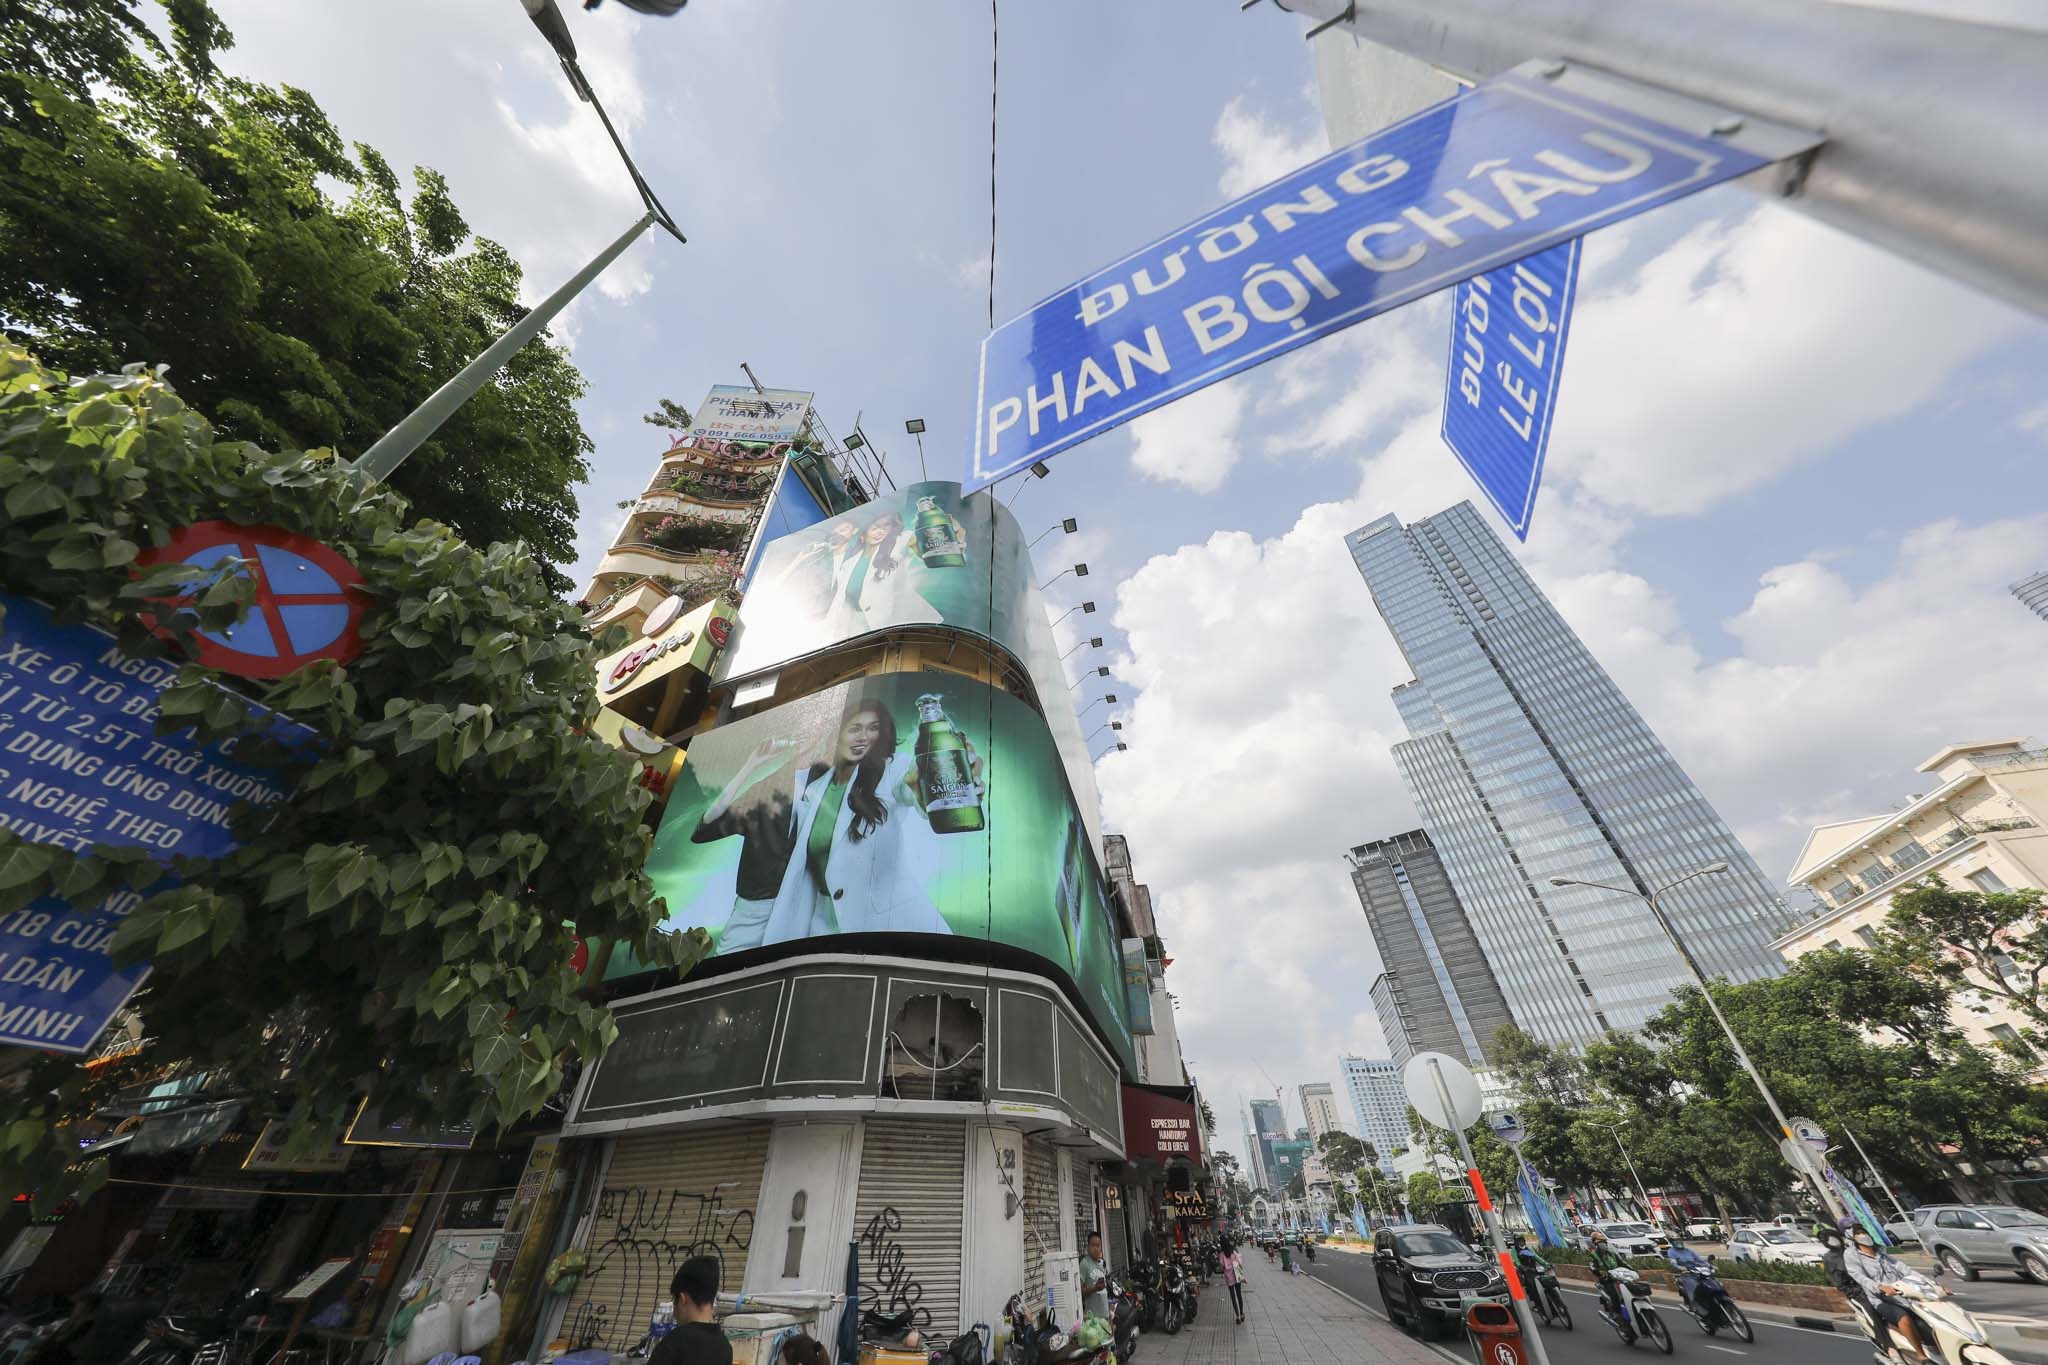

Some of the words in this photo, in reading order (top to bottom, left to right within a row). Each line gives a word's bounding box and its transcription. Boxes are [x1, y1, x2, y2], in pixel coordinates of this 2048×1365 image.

[1075, 154, 1410, 328] ĐƯỜNG
[988, 325, 1171, 456] PHAN
[1183, 255, 1341, 355] BỘI
[1346, 131, 1653, 273] CHÂU
[1509, 264, 1557, 369] LỢI
[1496, 361, 1537, 442] LÊ
[0, 643, 52, 674] XE
[48, 662, 83, 685] Ô
[79, 676, 126, 704] TÔ
[99, 648, 180, 693] NGOẠ
[5, 731, 103, 777] DỤNG
[101, 763, 170, 802] ỨNG
[20, 692, 75, 723] TỪ
[65, 714, 141, 751] 2,5T
[142, 741, 203, 776] TRỞ
[8, 778, 109, 827] NGHỆ
[106, 809, 184, 849] THEO
[930, 782, 967, 794] SAIGON
[1, 956, 85, 993] DÂN
[1151, 1118, 1178, 1129] ESPRESSO
[1179, 1119, 1191, 1129] BAR
[1157, 1141, 1172, 1152] COLD
[1172, 1141, 1190, 1152] BREW
